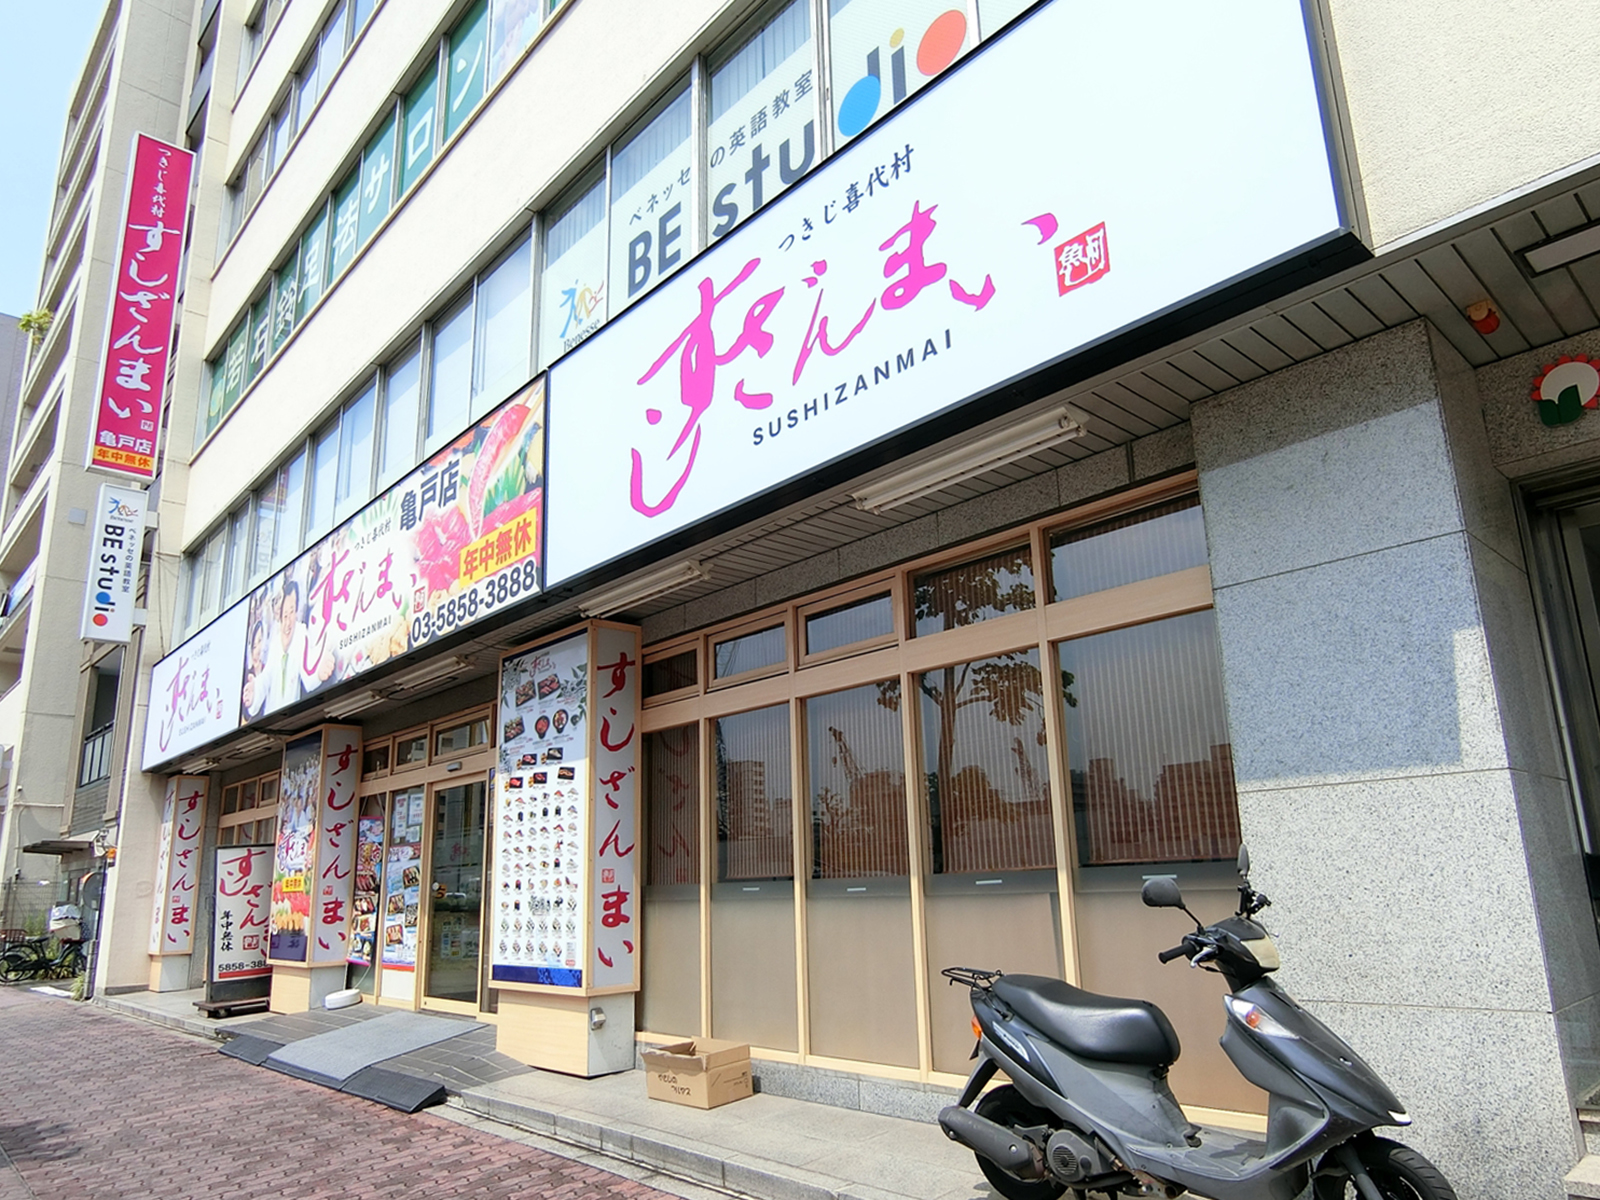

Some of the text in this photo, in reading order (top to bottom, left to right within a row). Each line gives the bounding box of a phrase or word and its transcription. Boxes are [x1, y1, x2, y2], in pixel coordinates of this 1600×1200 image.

[628, 69, 815, 228] ベネッセの英語教室
[777, 144, 915, 253] つきじ喜代村
[628, 201, 682, 299] BE
[107, 220, 181, 419] すしざんまい
[630, 200, 1059, 519] すしざんまい
[752, 328, 952, 447] SUSHIZANMAI
[96, 448, 151, 468] 年中無休
[99, 430, 153, 455] 亀戸店
[400, 457, 462, 532] 亀戸店
[92, 524, 125, 627] BE studio
[411, 558, 536, 643] 03-5858-3888
[462, 516, 533, 581] 年中無休
[303, 547, 418, 676] すしざんまい
[339, 615, 392, 650] SUSHIZANMAI
[316, 743, 360, 951] すしざんまい
[596, 651, 637, 968] すしざんまい
[167, 790, 205, 943] すしざんまい
[220, 909, 234, 952] 年中無休
